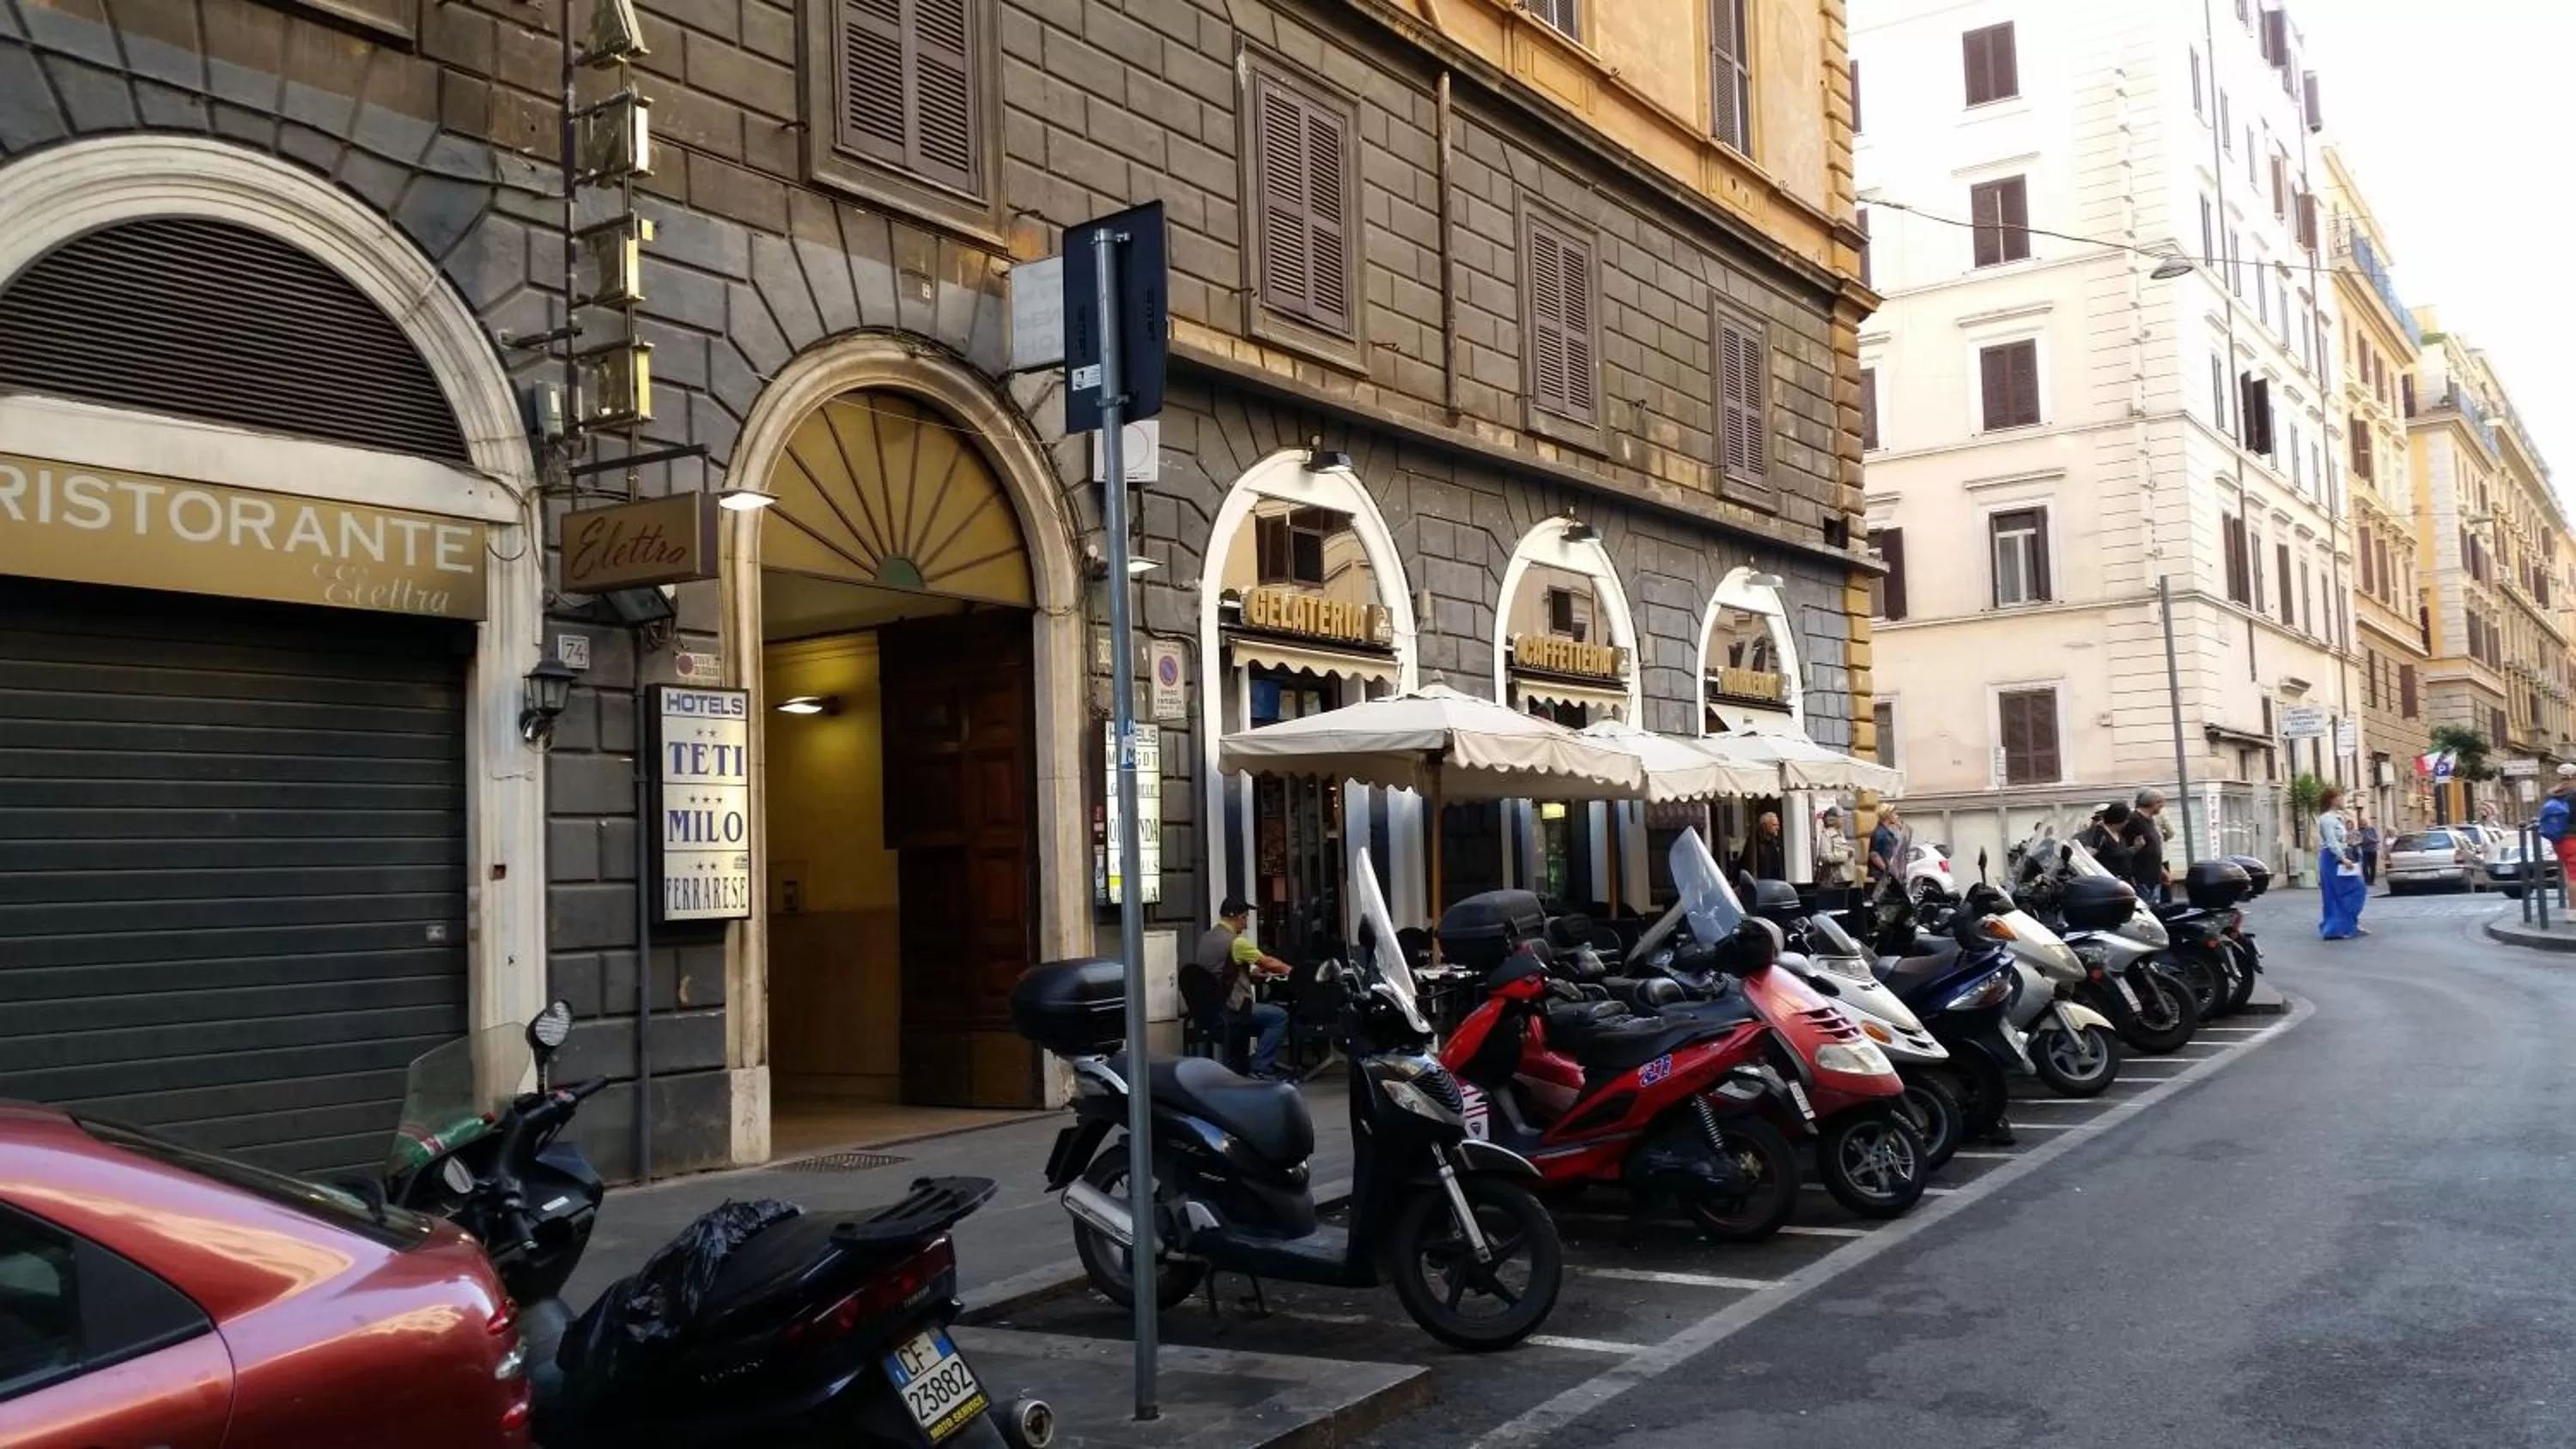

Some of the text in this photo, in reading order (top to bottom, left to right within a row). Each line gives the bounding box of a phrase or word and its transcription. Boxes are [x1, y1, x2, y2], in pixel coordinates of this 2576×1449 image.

[0, 464, 474, 574] RISTORANTE
[1252, 589, 1367, 641] GELATERIA
[566, 643, 584, 663] 74
[666, 693, 743, 715] HOTELS
[667, 741, 744, 776] TETI
[668, 809, 744, 843] MILO
[665, 876, 746, 910] FERRARESE
[899, 1341, 924, 1376] CF
[908, 1361, 974, 1421] 23882
